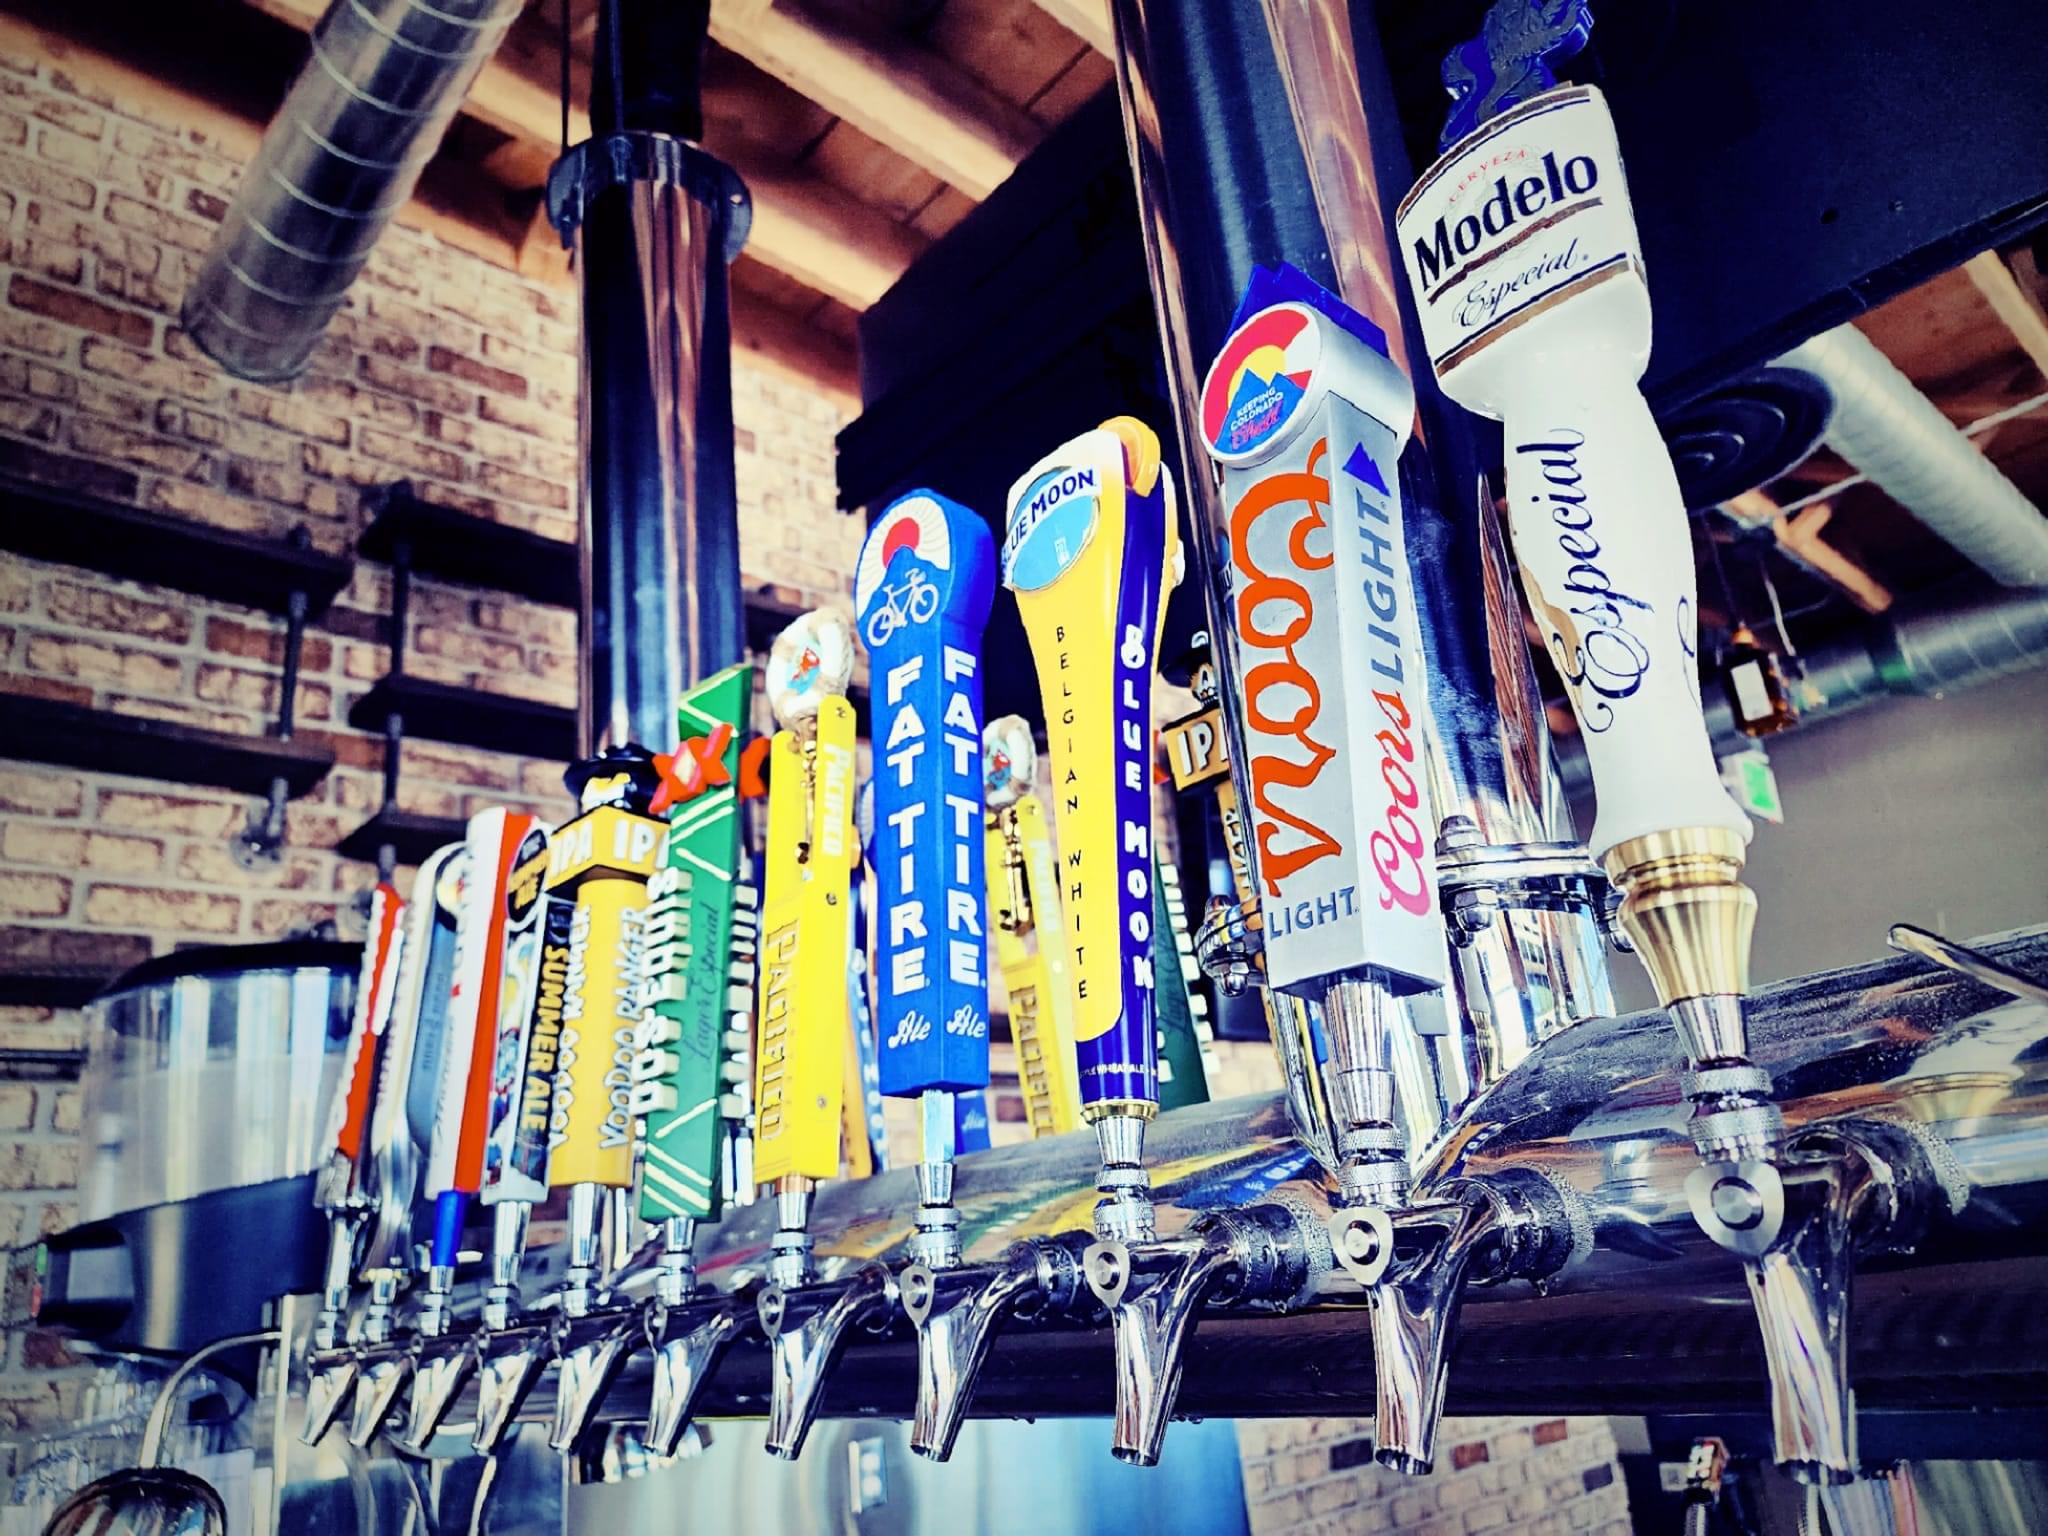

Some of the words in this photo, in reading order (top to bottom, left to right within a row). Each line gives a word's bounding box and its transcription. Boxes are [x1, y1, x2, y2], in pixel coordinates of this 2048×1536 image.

[1413, 151, 1598, 292] Modelo
[1448, 148, 1529, 204] CERVEZA
[1452, 238, 1578, 327] Especial
[1230, 391, 1284, 432] COLORADO
[1236, 386, 1276, 417] KEEPING
[1031, 469, 1095, 523] MOON
[1355, 488, 1404, 684] LIGHT
[1515, 426, 1655, 733] Especial
[886, 655, 926, 788] FAT
[943, 645, 979, 777] FAT
[1120, 624, 1147, 791] BLUE
[1230, 437, 1342, 898] Coors
[551, 820, 593, 880] IPA
[1056, 626, 1078, 814] BELGIAN
[1068, 849, 1088, 999] WHITE
[1372, 690, 1430, 916] Coors
[636, 866, 692, 1011] EQUIS
[887, 799, 929, 997] TIRE
[944, 793, 986, 989] TIRE
[1124, 819, 1156, 988] MOON
[1268, 886, 1354, 940] LIGHT
[529, 944, 569, 1073] SUMMER
[629, 1010, 682, 1114] DOS
[759, 918, 800, 1140] PACIFICO
[887, 1009, 931, 1050] Ale
[946, 1003, 987, 1040] Ale
[519, 1075, 551, 1132] ALE
[598, 1026, 638, 1150] VOODOO
